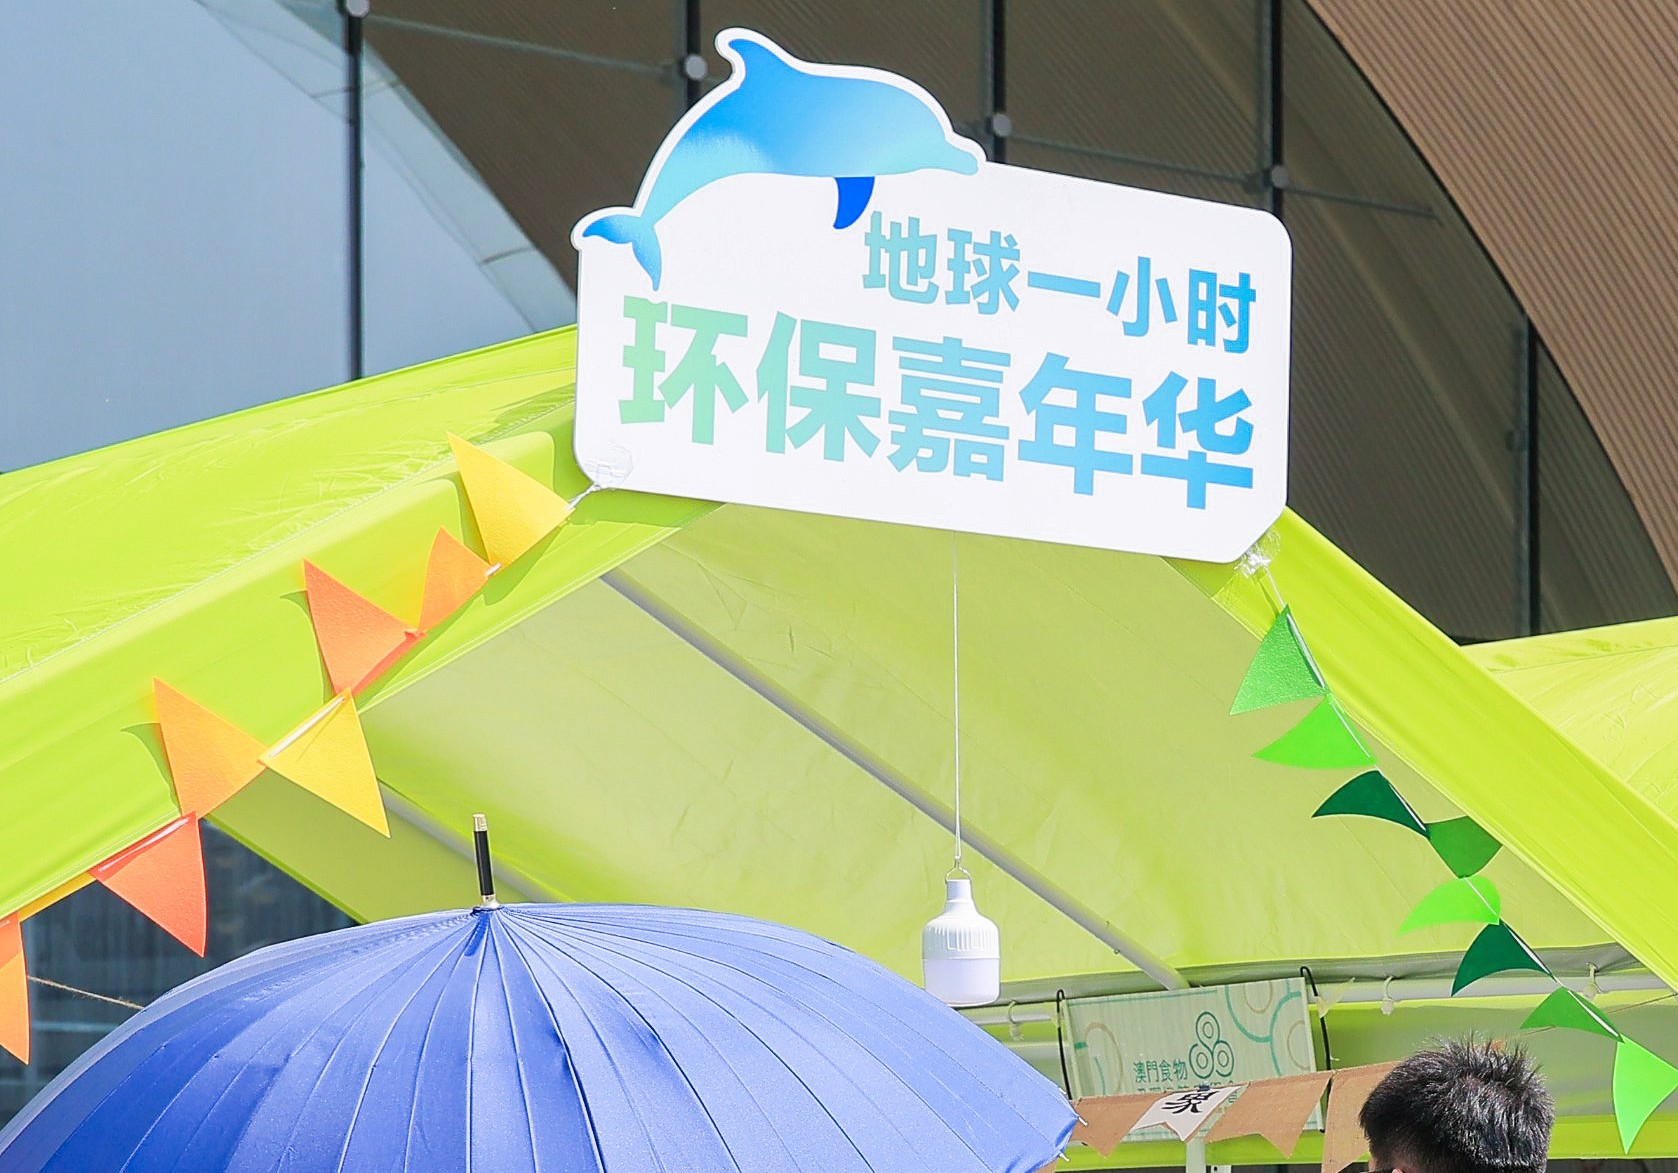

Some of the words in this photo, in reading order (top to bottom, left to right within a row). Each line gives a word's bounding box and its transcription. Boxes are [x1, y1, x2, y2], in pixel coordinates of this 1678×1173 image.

[862, 210, 1257, 354] 地球一小时
[618, 295, 1255, 510] 环保嘉年华
[1133, 1059, 1188, 1083] 澳門食物
